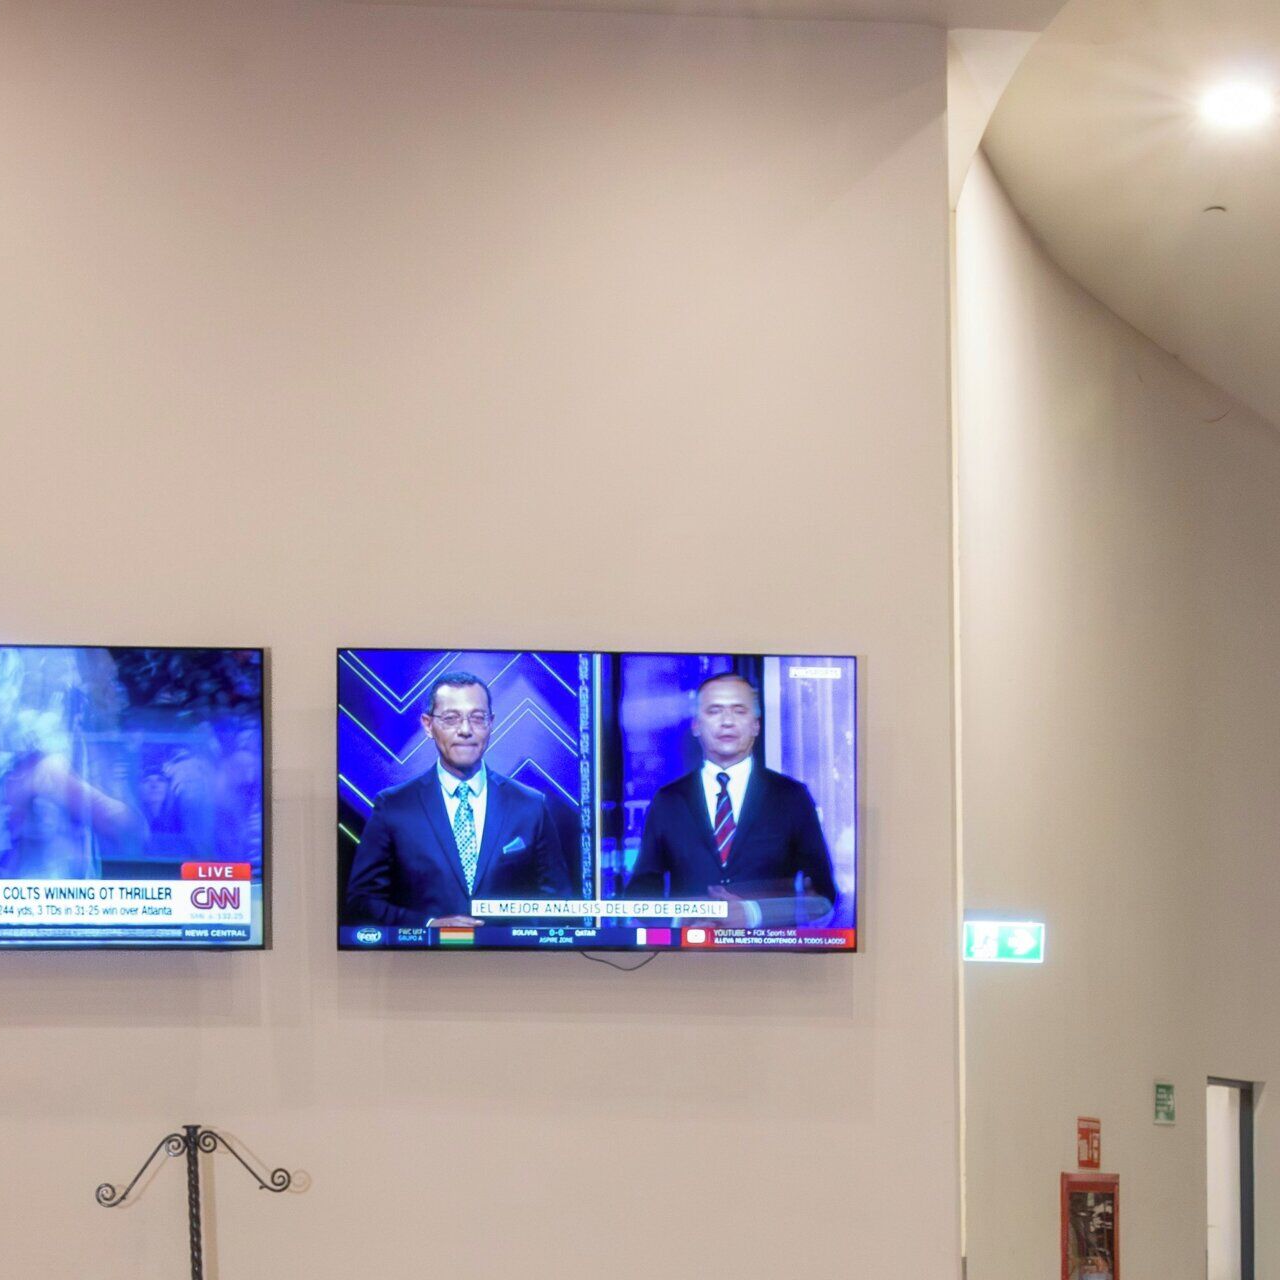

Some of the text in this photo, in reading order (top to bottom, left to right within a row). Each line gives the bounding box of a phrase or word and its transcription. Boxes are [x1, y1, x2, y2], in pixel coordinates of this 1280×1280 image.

[197, 866, 233, 877] LIVE
[3, 887, 40, 900] COLTS
[45, 887, 95, 900] WINNING
[99, 887, 115, 900] OT
[118, 887, 172, 900] THRILLER
[190, 886, 240, 910] CNN
[17, 905, 35, 917] yds,
[37, 905, 43, 915] 3
[45, 905, 62, 915] TDs
[65, 905, 72, 915] in
[102, 906, 118, 915] win
[121, 907, 138, 915] over
[142, 905, 173, 915] Atlanta
[499, 903, 539, 914] MEJOR
[544, 900, 601, 914] ANÁLISIS
[606, 903, 628, 914] DEL
[634, 904, 650, 914] GP
[654, 904, 670, 914] DE
[674, 904, 722, 915] BRASIL!
[184, 929, 209, 937] NEWS
[210, 929, 247, 937] CENTRAL
[512, 929, 538, 937] BOLIVIA
[574, 929, 597, 937] QATAR
[713, 929, 745, 937] YOUTUBE
[804, 937, 824, 945] TODOS
